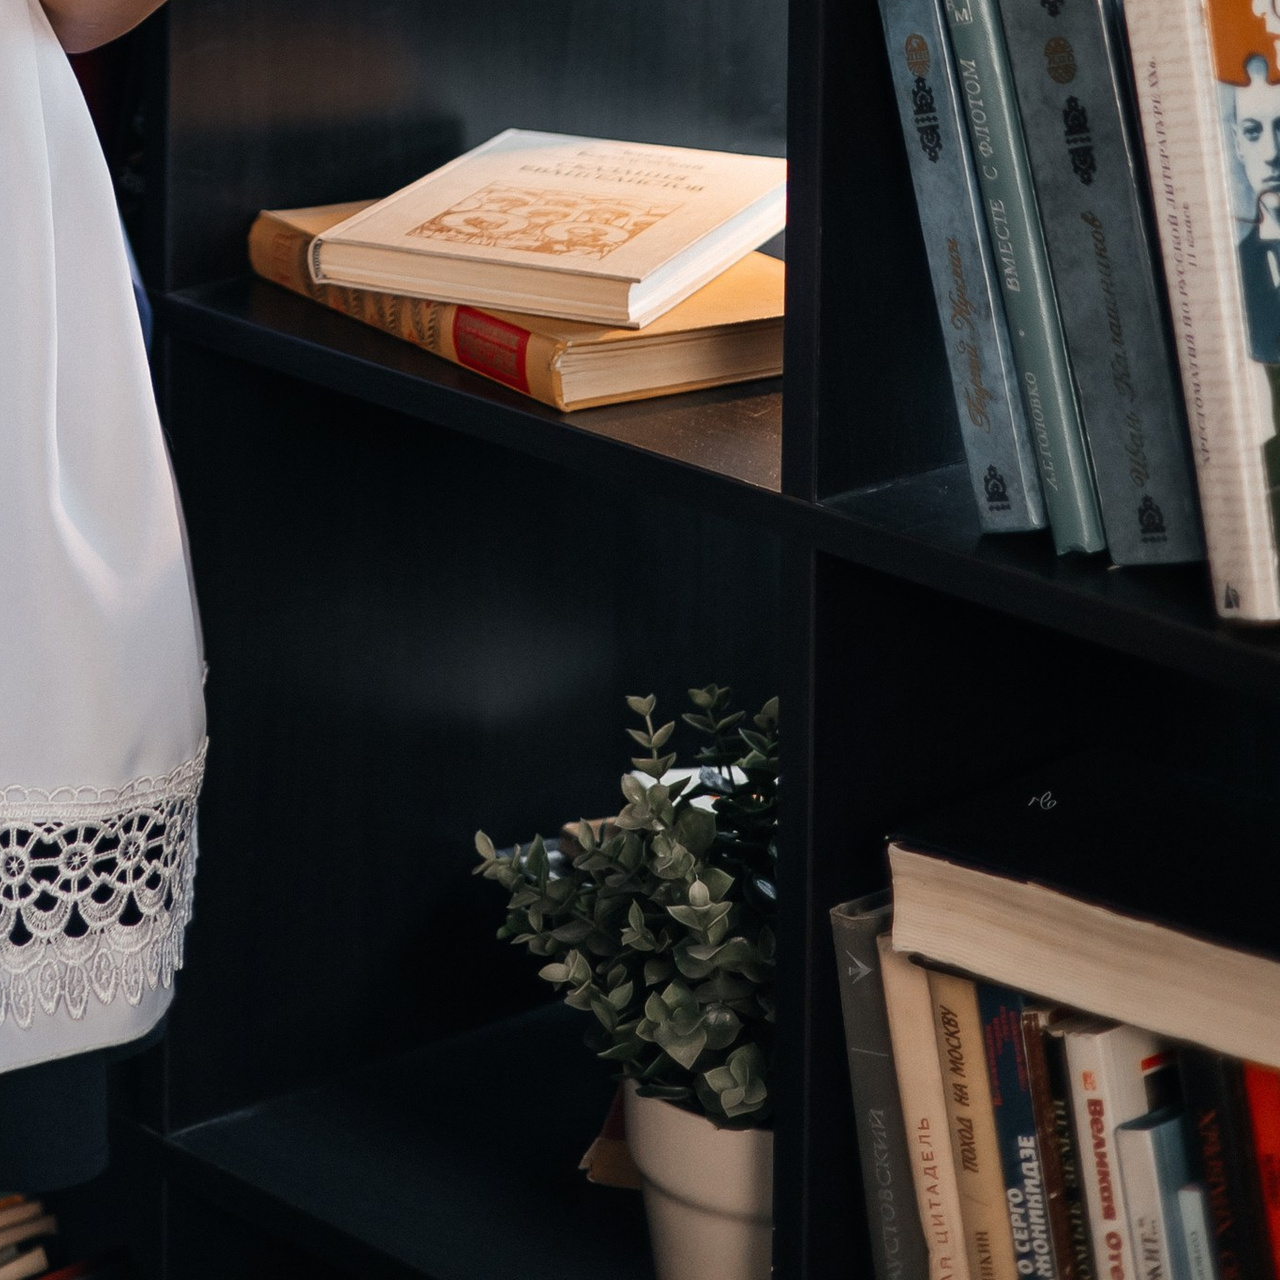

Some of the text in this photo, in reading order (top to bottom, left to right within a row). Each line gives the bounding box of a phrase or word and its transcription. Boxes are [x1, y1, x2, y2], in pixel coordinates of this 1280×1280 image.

[960, 58, 994, 159] ФЛОТОМ
[983, 165, 998, 181] С
[990, 198, 1021, 292] ВМЕСТЕ
[940, 1004, 967, 1078] МОСКВУ
[955, 1083, 970, 1108] НА
[960, 1117, 979, 1174] ПОХОД
[918, 1117, 949, 1246] ЦИТАДЕЛЬ
[1007, 1187, 1031, 1251] СЕРГО
